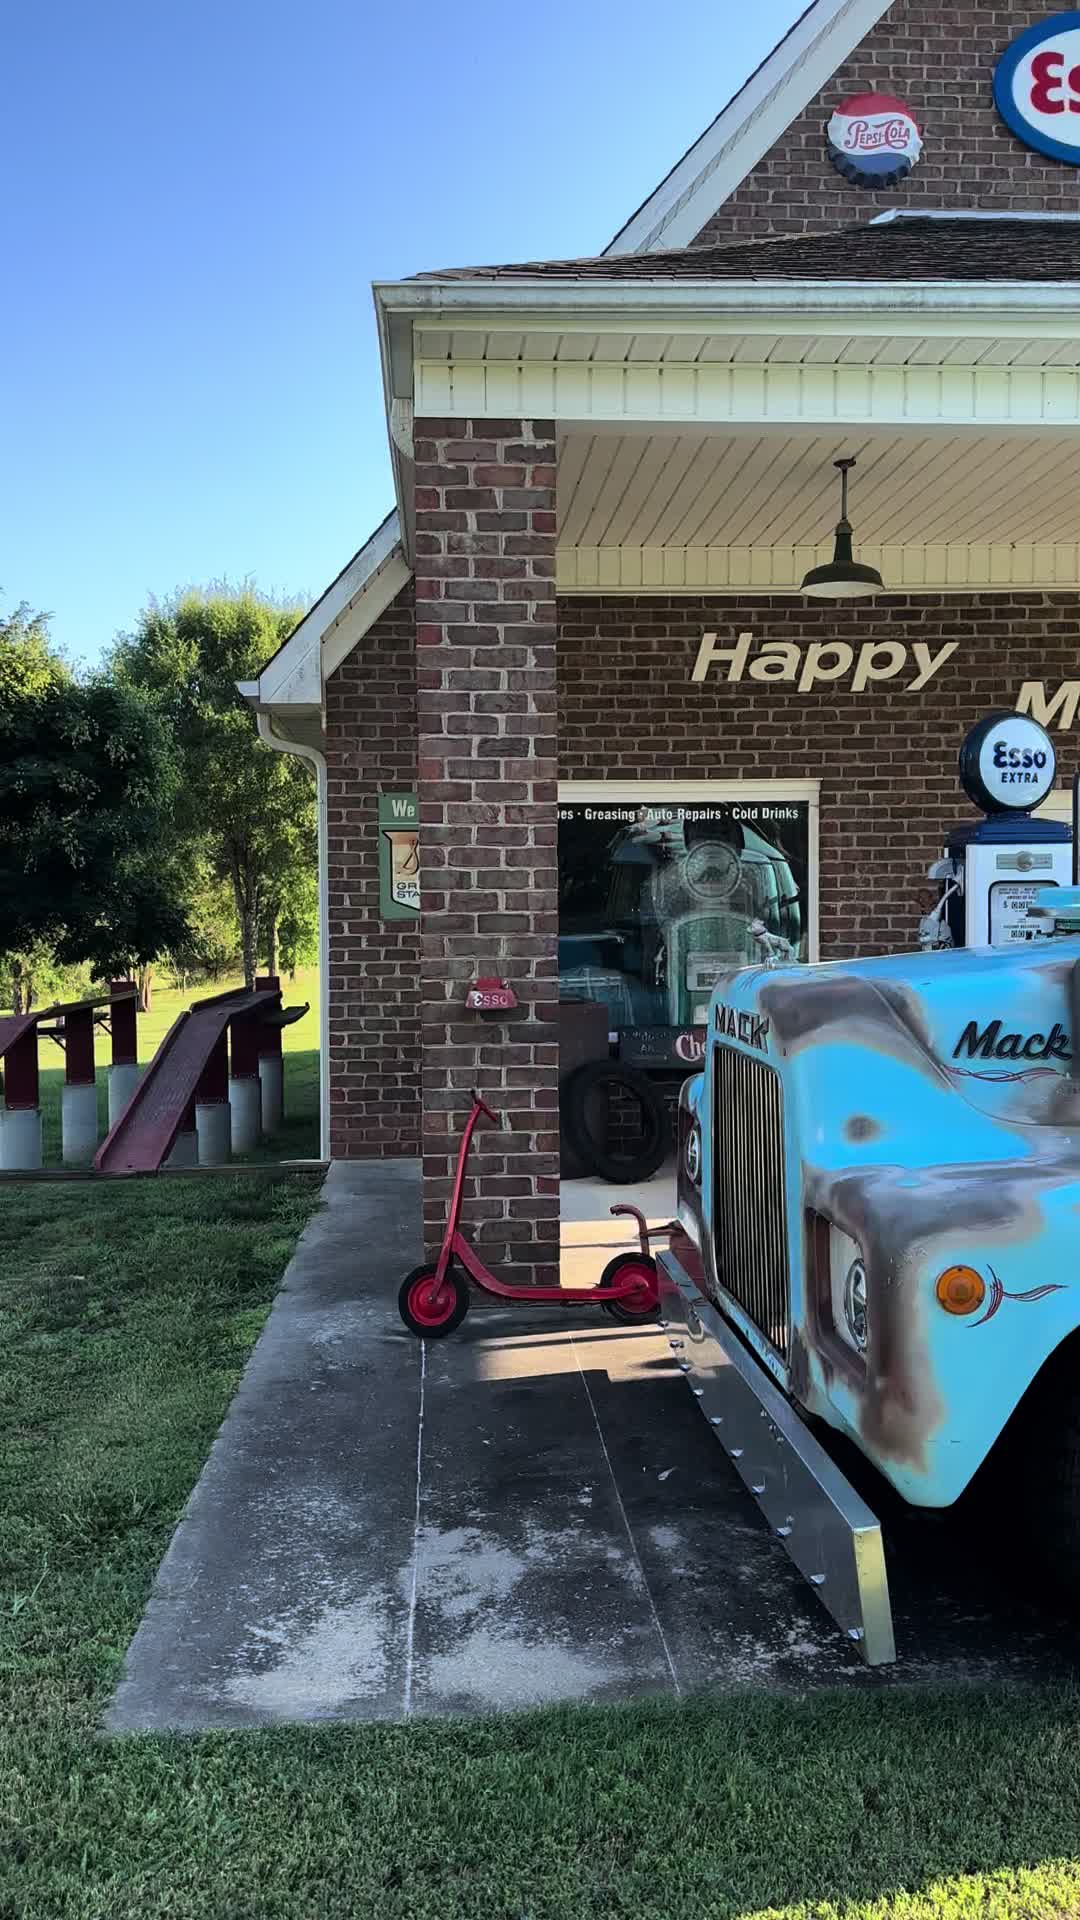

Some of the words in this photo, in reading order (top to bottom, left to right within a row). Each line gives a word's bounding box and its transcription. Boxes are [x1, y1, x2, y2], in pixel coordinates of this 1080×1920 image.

[691, 632, 960, 693] Happy
[1015, 681, 1080, 730] M
[1001, 772, 1039, 784] EXTRA
[391, 799, 416, 817] We
[557, 809, 574, 820] es
[584, 808, 636, 822] Greasing
[647, 808, 673, 820] Auto
[677, 808, 721, 822] Repairs
[732, 807, 758, 819] Cold
[762, 807, 799, 819] Drinks
[715, 1003, 769, 1055] MACK
[952, 1019, 1072, 1061] Mack
